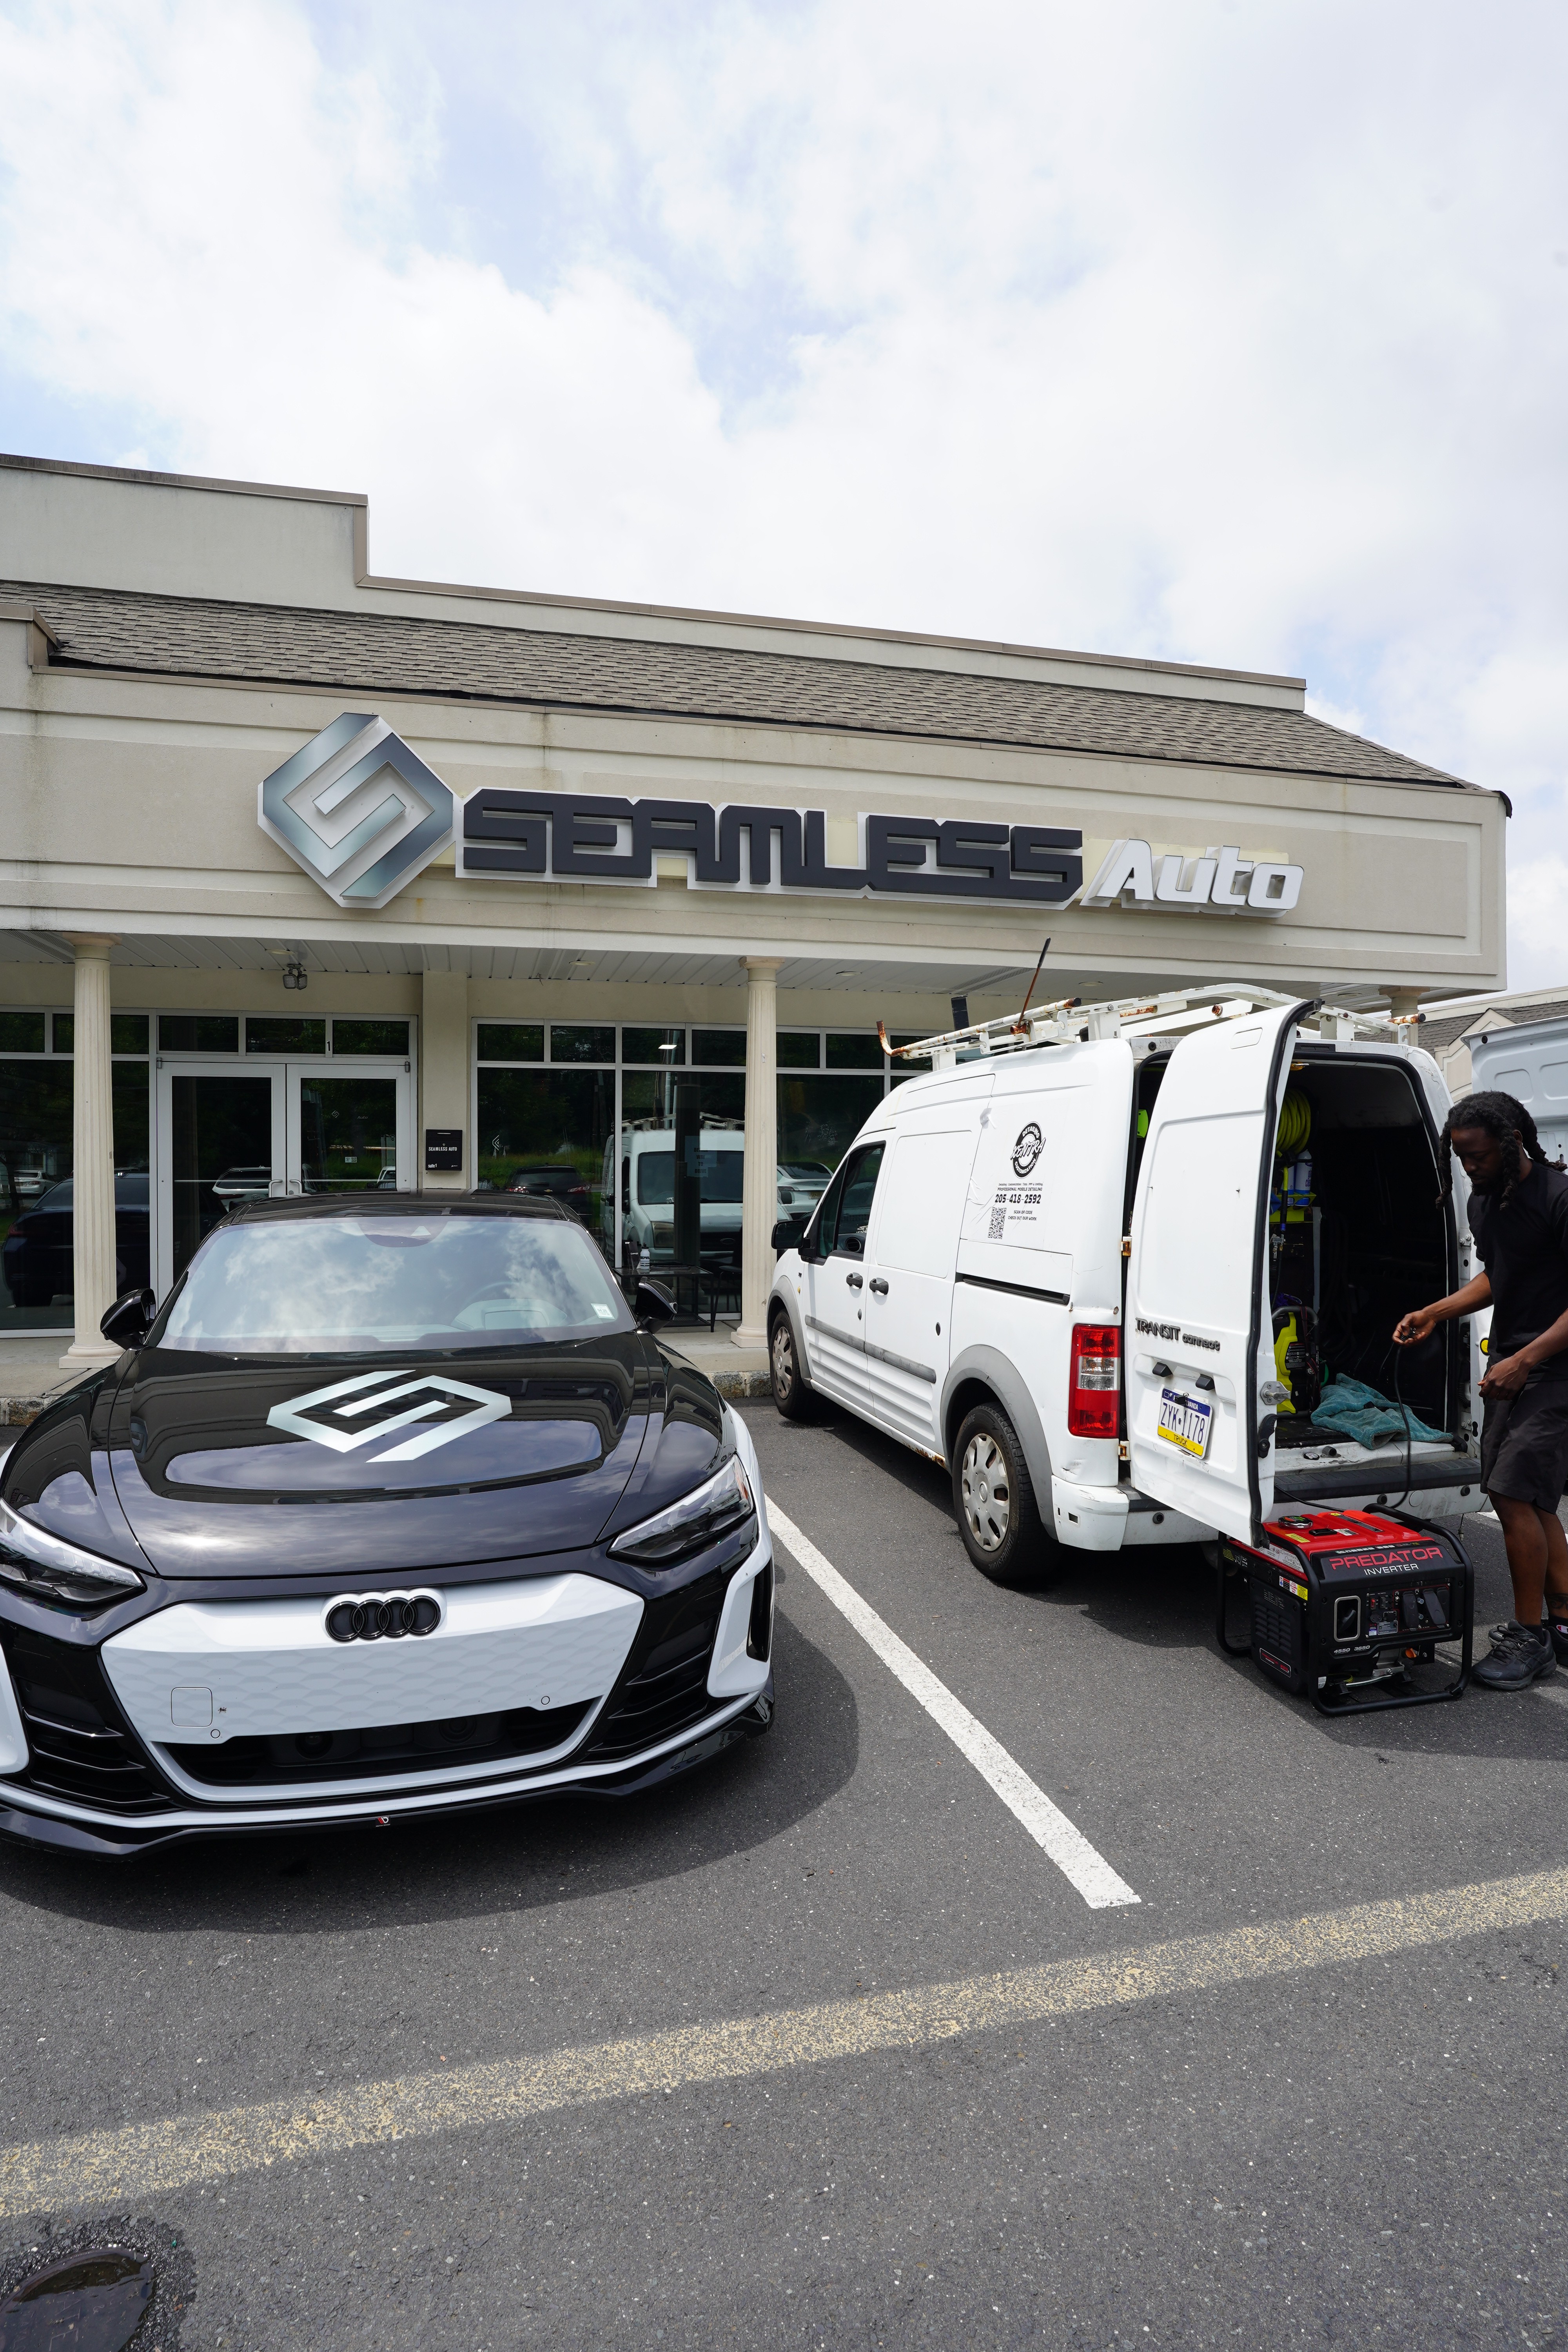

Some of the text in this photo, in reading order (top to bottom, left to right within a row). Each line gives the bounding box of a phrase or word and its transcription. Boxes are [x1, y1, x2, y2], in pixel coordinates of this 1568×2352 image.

[464, 787, 1305, 909] SEAMLESS Auto
[327, 1041, 330, 1051] 1
[1022, 1126, 1040, 1138] DETAILING
[1014, 1158, 1036, 1174] CUSTOMIZATION
[995, 1194, 1041, 1204] 205-418-2592
[1135, 1318, 1220, 1351] TRANSIT connect
[1173, 1434, 1188, 1446] TRUCK
[1329, 1547, 1443, 1570] PREDATOR
[1364, 1563, 1419, 1576] INVERTER
